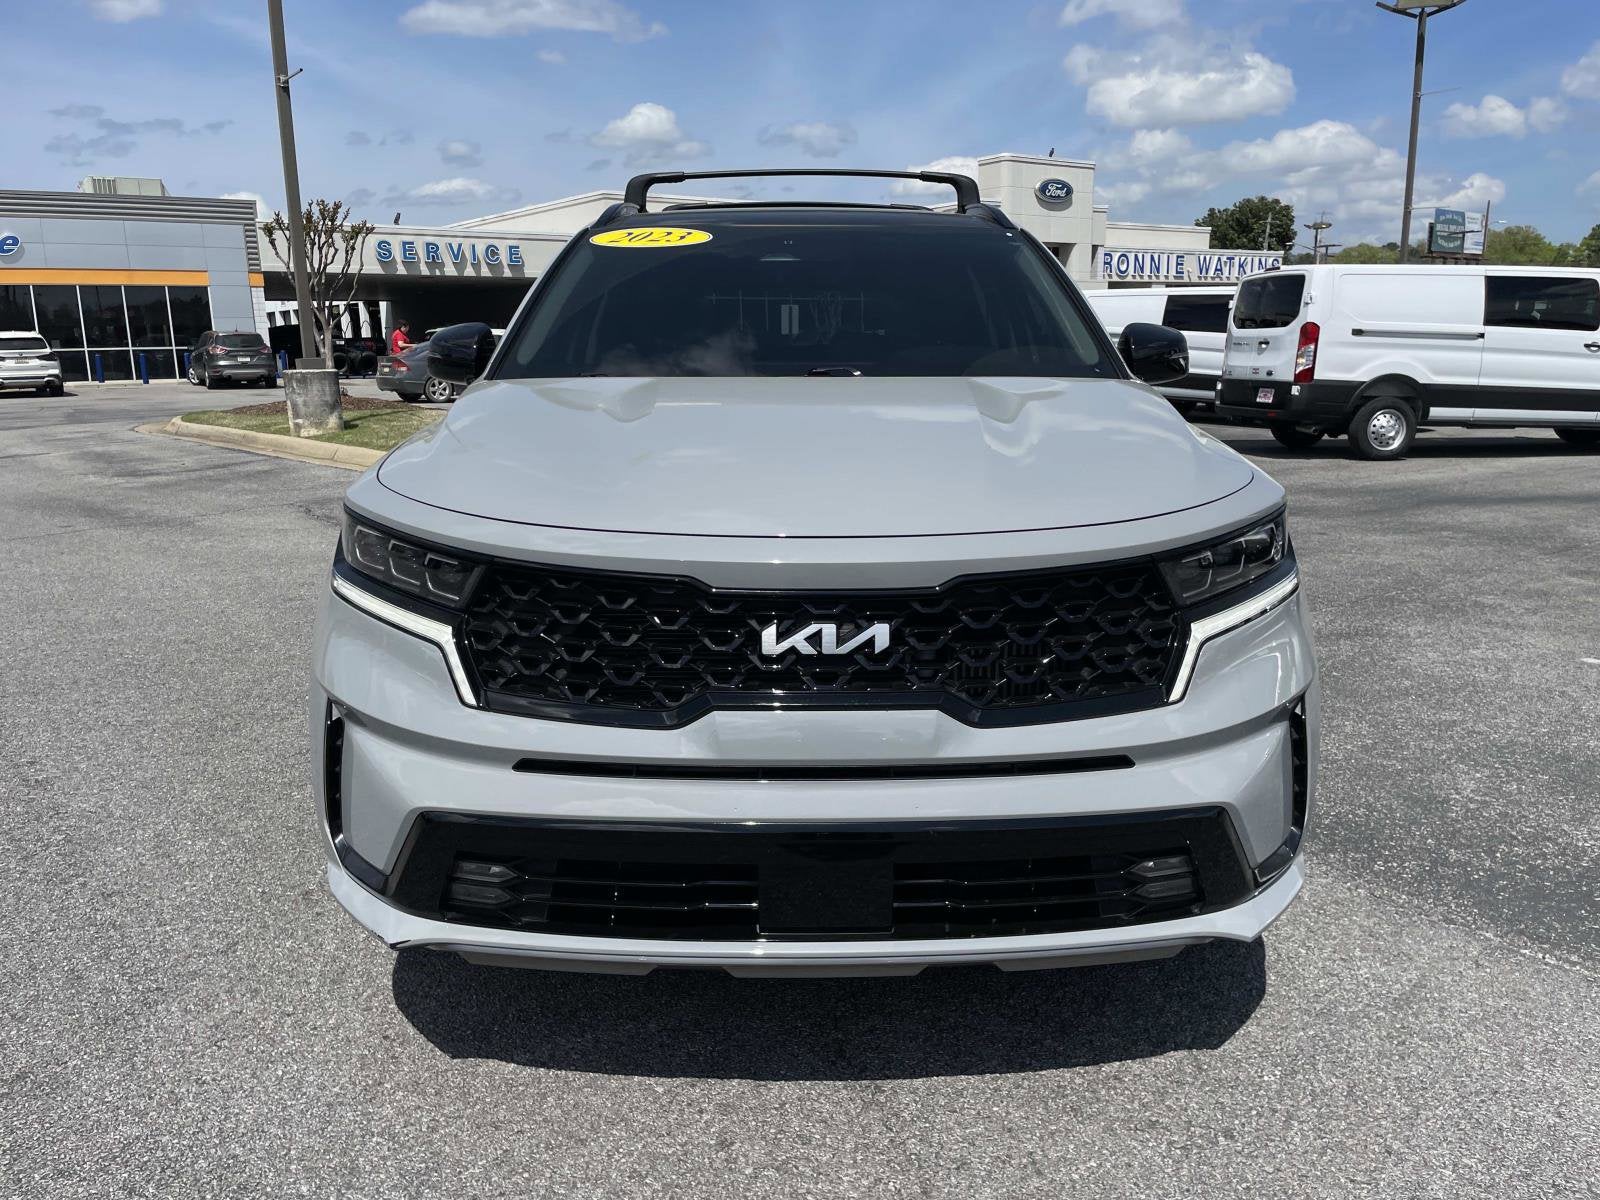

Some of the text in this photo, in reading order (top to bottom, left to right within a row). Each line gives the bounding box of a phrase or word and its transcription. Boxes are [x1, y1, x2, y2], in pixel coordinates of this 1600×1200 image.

[1045, 182, 1067, 197] Ford
[609, 230, 693, 244] 2023
[375, 239, 522, 265] SERVICE
[1103, 252, 1280, 276] RONNIE WATKINS
[761, 622, 890, 655] KIA
